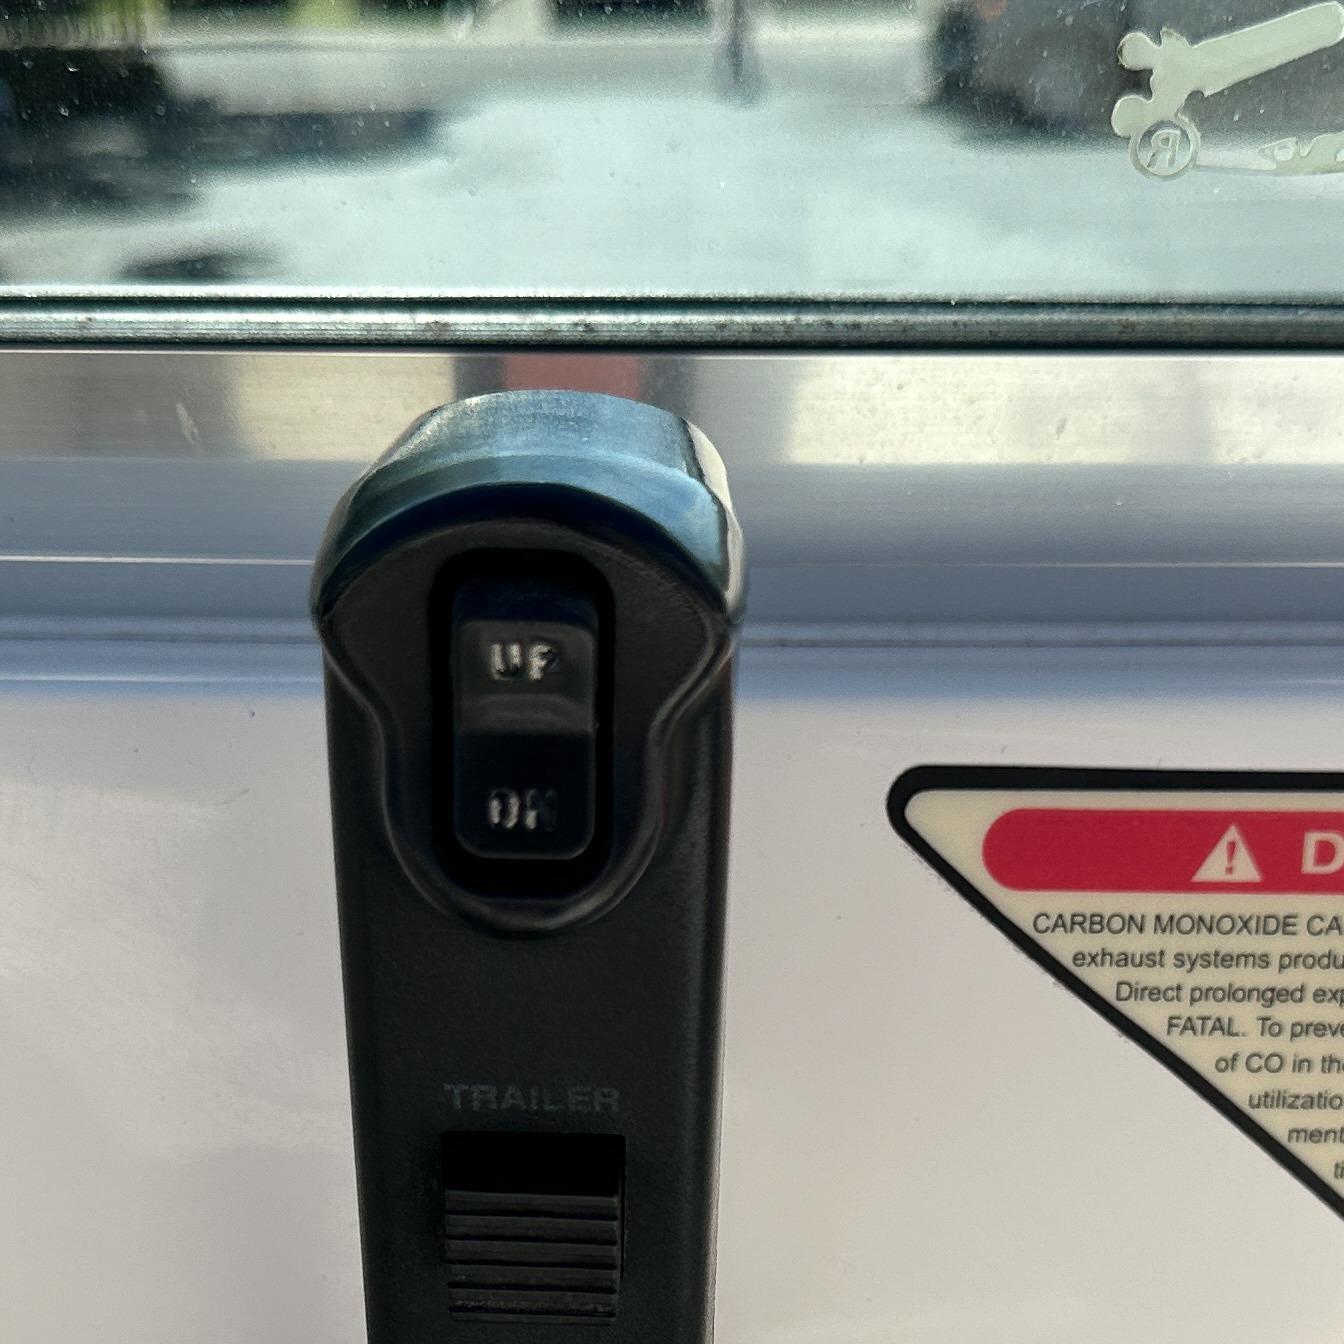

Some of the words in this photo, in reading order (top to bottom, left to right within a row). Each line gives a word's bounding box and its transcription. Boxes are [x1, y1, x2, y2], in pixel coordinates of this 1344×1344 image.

[490, 643, 556, 681] UP
[1032, 912, 1145, 936] CARBON
[1152, 912, 1300, 937] MONOXIDE
[1071, 949, 1166, 970] exhaust
[1172, 949, 1272, 975] systems
[1114, 981, 1183, 1003] Direct
[1188, 982, 1307, 1009] prolonged
[443, 1083, 621, 1112] TRAILER
